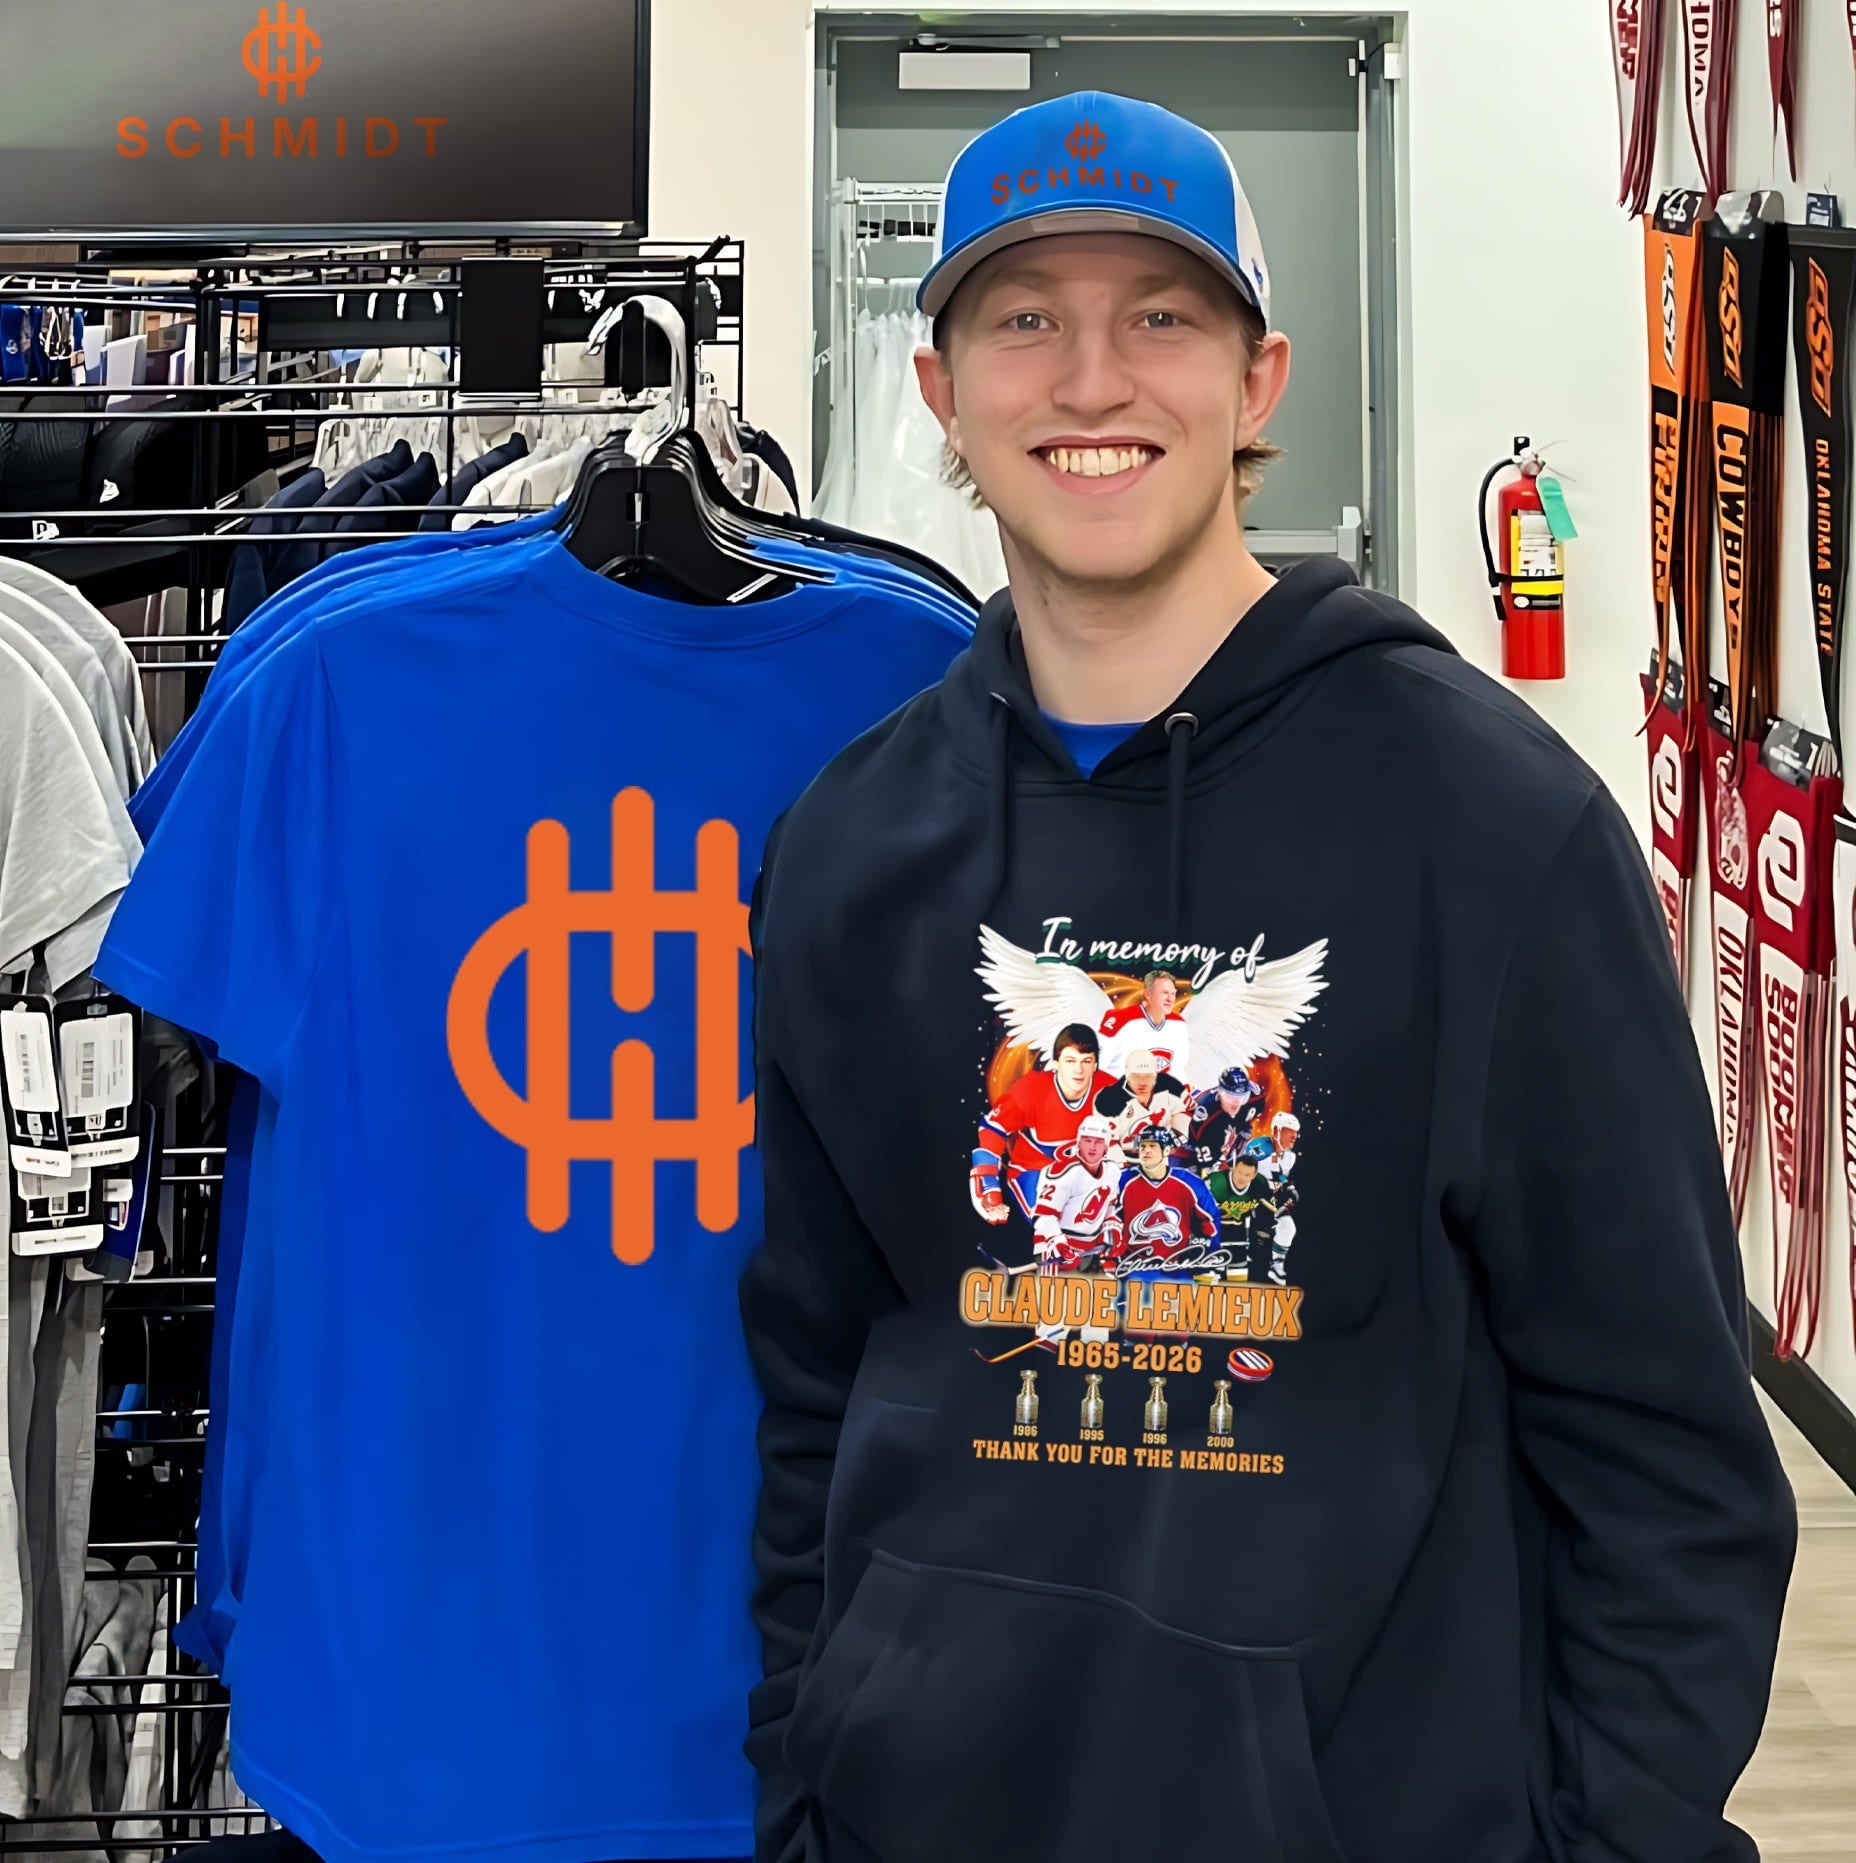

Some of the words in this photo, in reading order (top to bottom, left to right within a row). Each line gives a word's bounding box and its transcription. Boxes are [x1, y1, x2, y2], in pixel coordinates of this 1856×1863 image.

[115, 116, 448, 159] SCHMIDT
[991, 166, 1180, 205] SCHMIDT
[1718, 246, 1745, 389] OSU
[1805, 257, 1834, 418] OSU
[1815, 439, 1832, 570] OKLAHOMA
[1757, 809, 1806, 933] OU
[1035, 916, 1083, 963] In
[1089, 936, 1226, 993] memory
[1230, 932, 1265, 982] of
[963, 1271, 1119, 1329] CLAUDE
[1126, 1280, 1304, 1338] LEMIEUX
[1057, 1339, 1203, 1374] 1965-2026
[1013, 1424, 1038, 1438] 1986
[1079, 1428, 1105, 1441] 1995
[1142, 1432, 1168, 1445] 1996
[1206, 1435, 1235, 1448] 2000
[972, 1438, 1040, 1462] THANK
[1045, 1444, 1084, 1464] YOU
[1089, 1446, 1127, 1467] FOR
[1133, 1447, 1174, 1468] THE
[1179, 1451, 1285, 1475] MEMORIES
